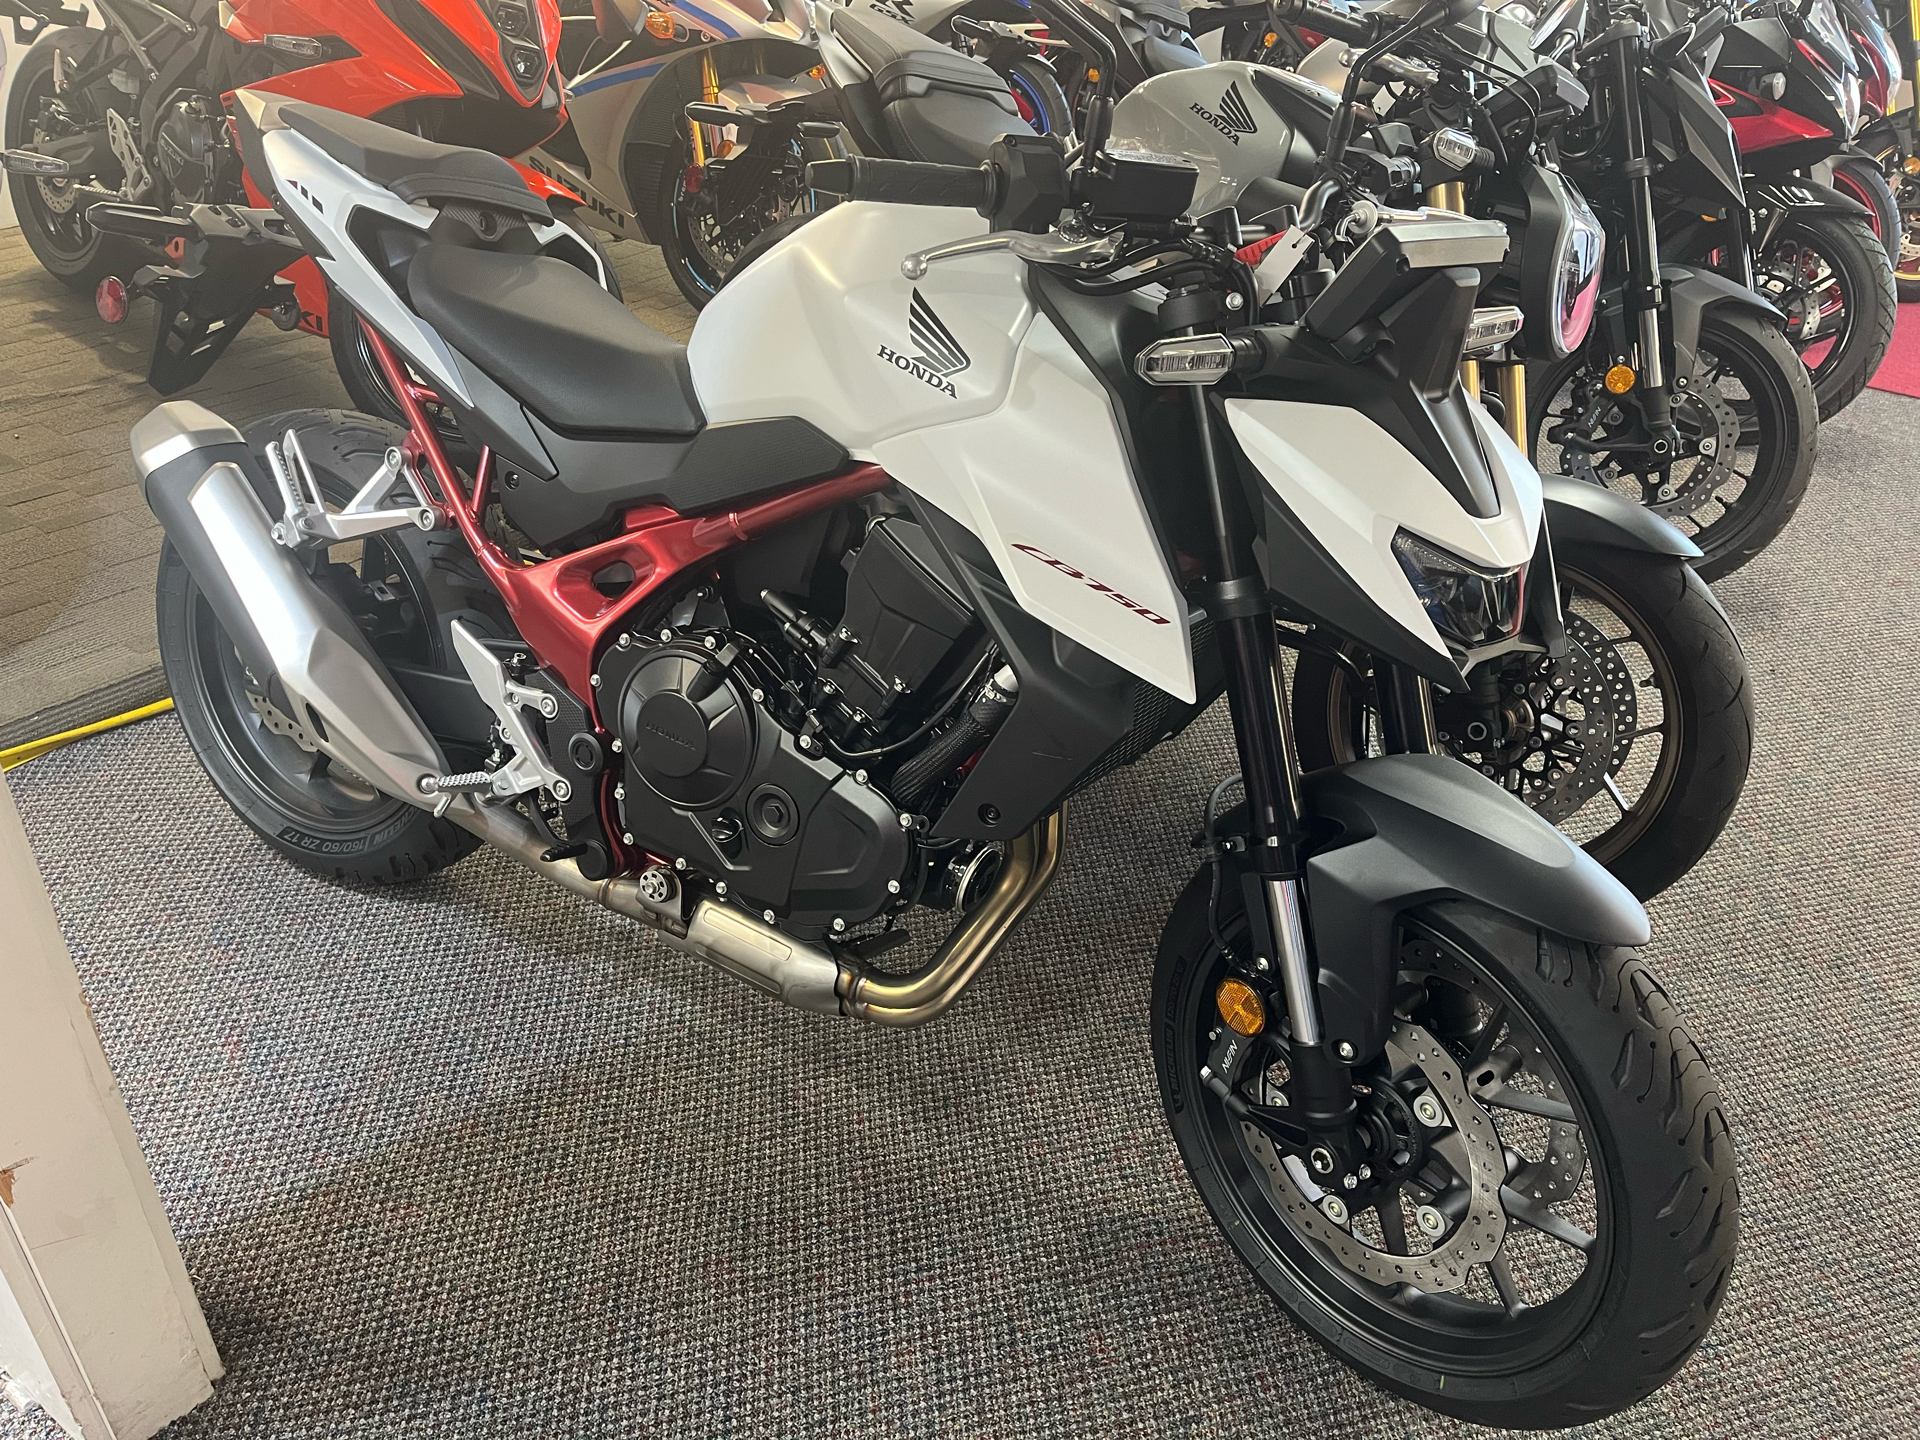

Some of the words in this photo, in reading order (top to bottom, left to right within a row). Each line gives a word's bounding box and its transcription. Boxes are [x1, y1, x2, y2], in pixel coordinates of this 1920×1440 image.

[1189, 102, 1240, 146] HONDA
[877, 344, 958, 399] HONDA
[1011, 543, 1171, 625] CB750
[645, 721, 696, 751] HONDA
[283, 831, 299, 842] 17
[300, 836, 321, 850] ZR
[322, 840, 364, 853] 160/60
[1165, 1028, 1179, 1090] MICHELIN
